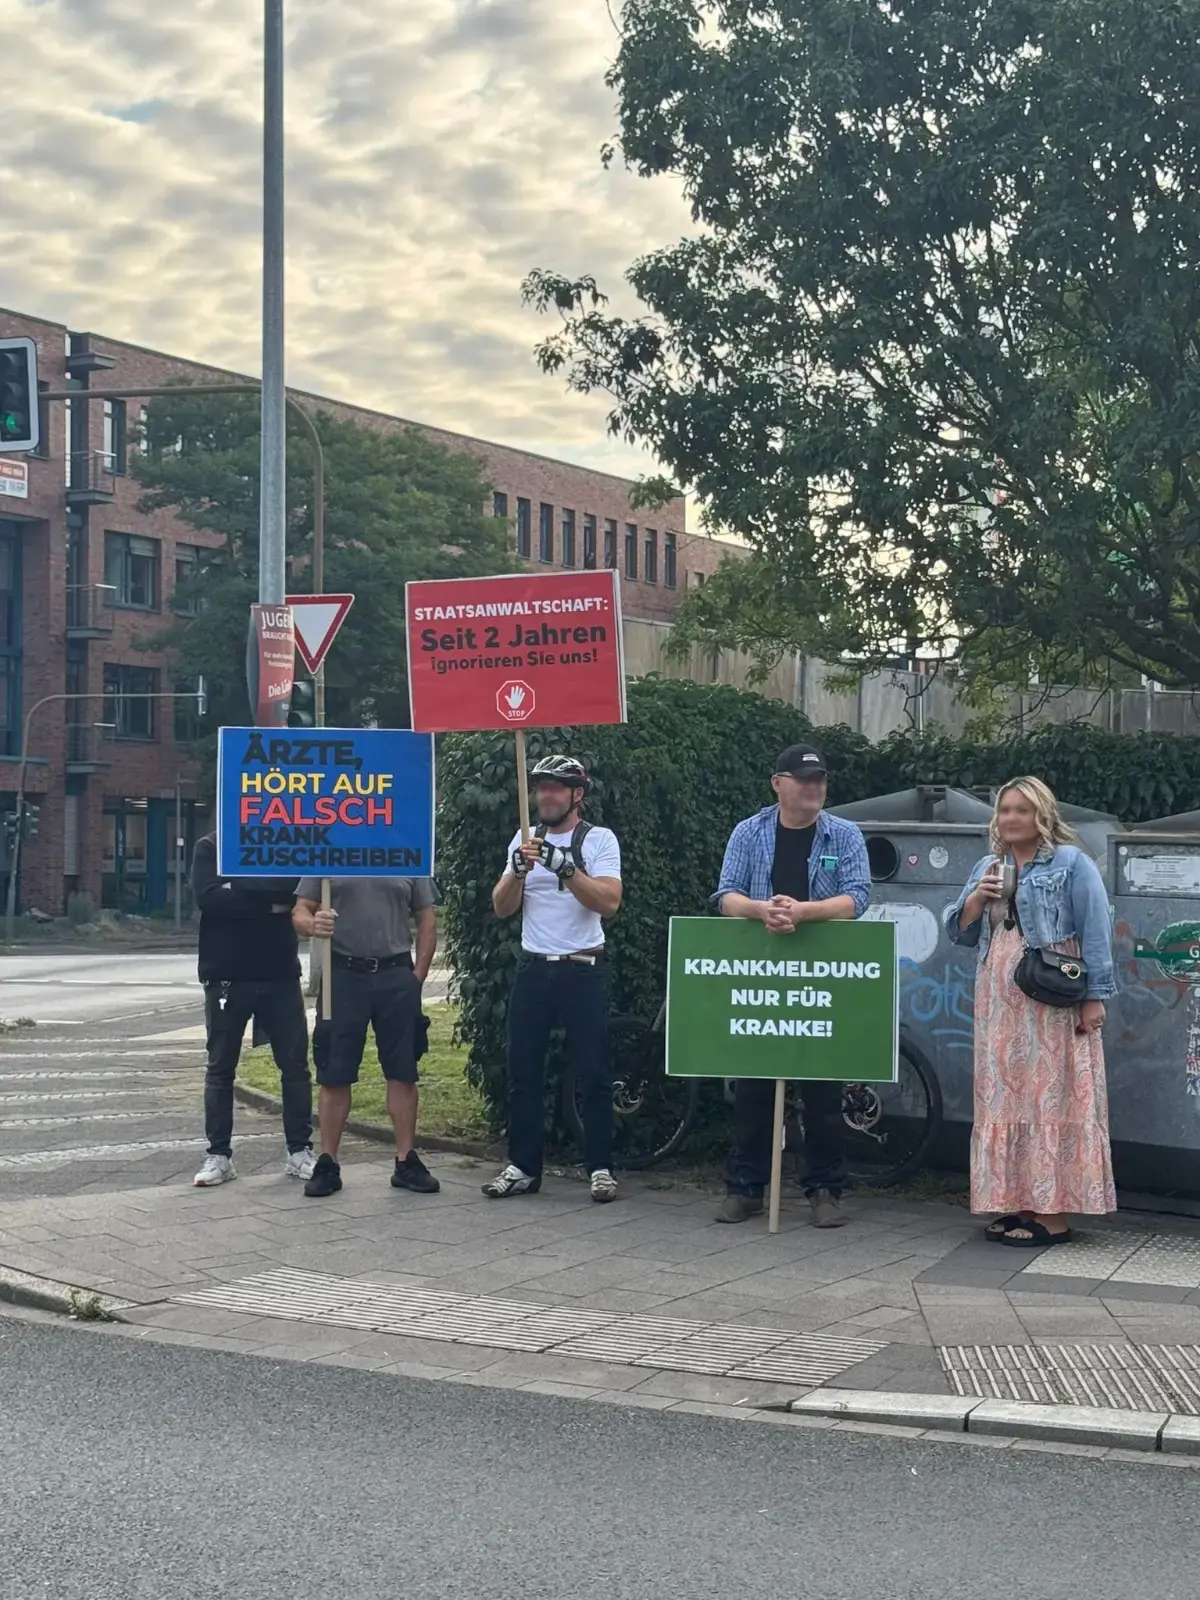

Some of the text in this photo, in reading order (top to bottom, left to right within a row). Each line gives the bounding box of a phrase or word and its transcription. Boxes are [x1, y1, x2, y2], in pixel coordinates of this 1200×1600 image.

[415, 597, 609, 621] STAATSANWALTSCHAFT:
[420, 623, 606, 652] Seit 2 Jahren
[431, 649, 598, 674] ignorieren Sie uns!
[508, 710, 525, 718] STOP
[242, 732, 363, 770] ÄRZTE,
[241, 767, 394, 795] HÖRT AUF
[239, 796, 394, 826] FALSCH
[239, 826, 331, 846] KRANK
[239, 847, 421, 867] ZUSCHREIBEN
[684, 958, 881, 979] KRANKMELDUNG
[731, 986, 832, 1008] NUR FÜR
[730, 1019, 833, 1037] KRANKE!
